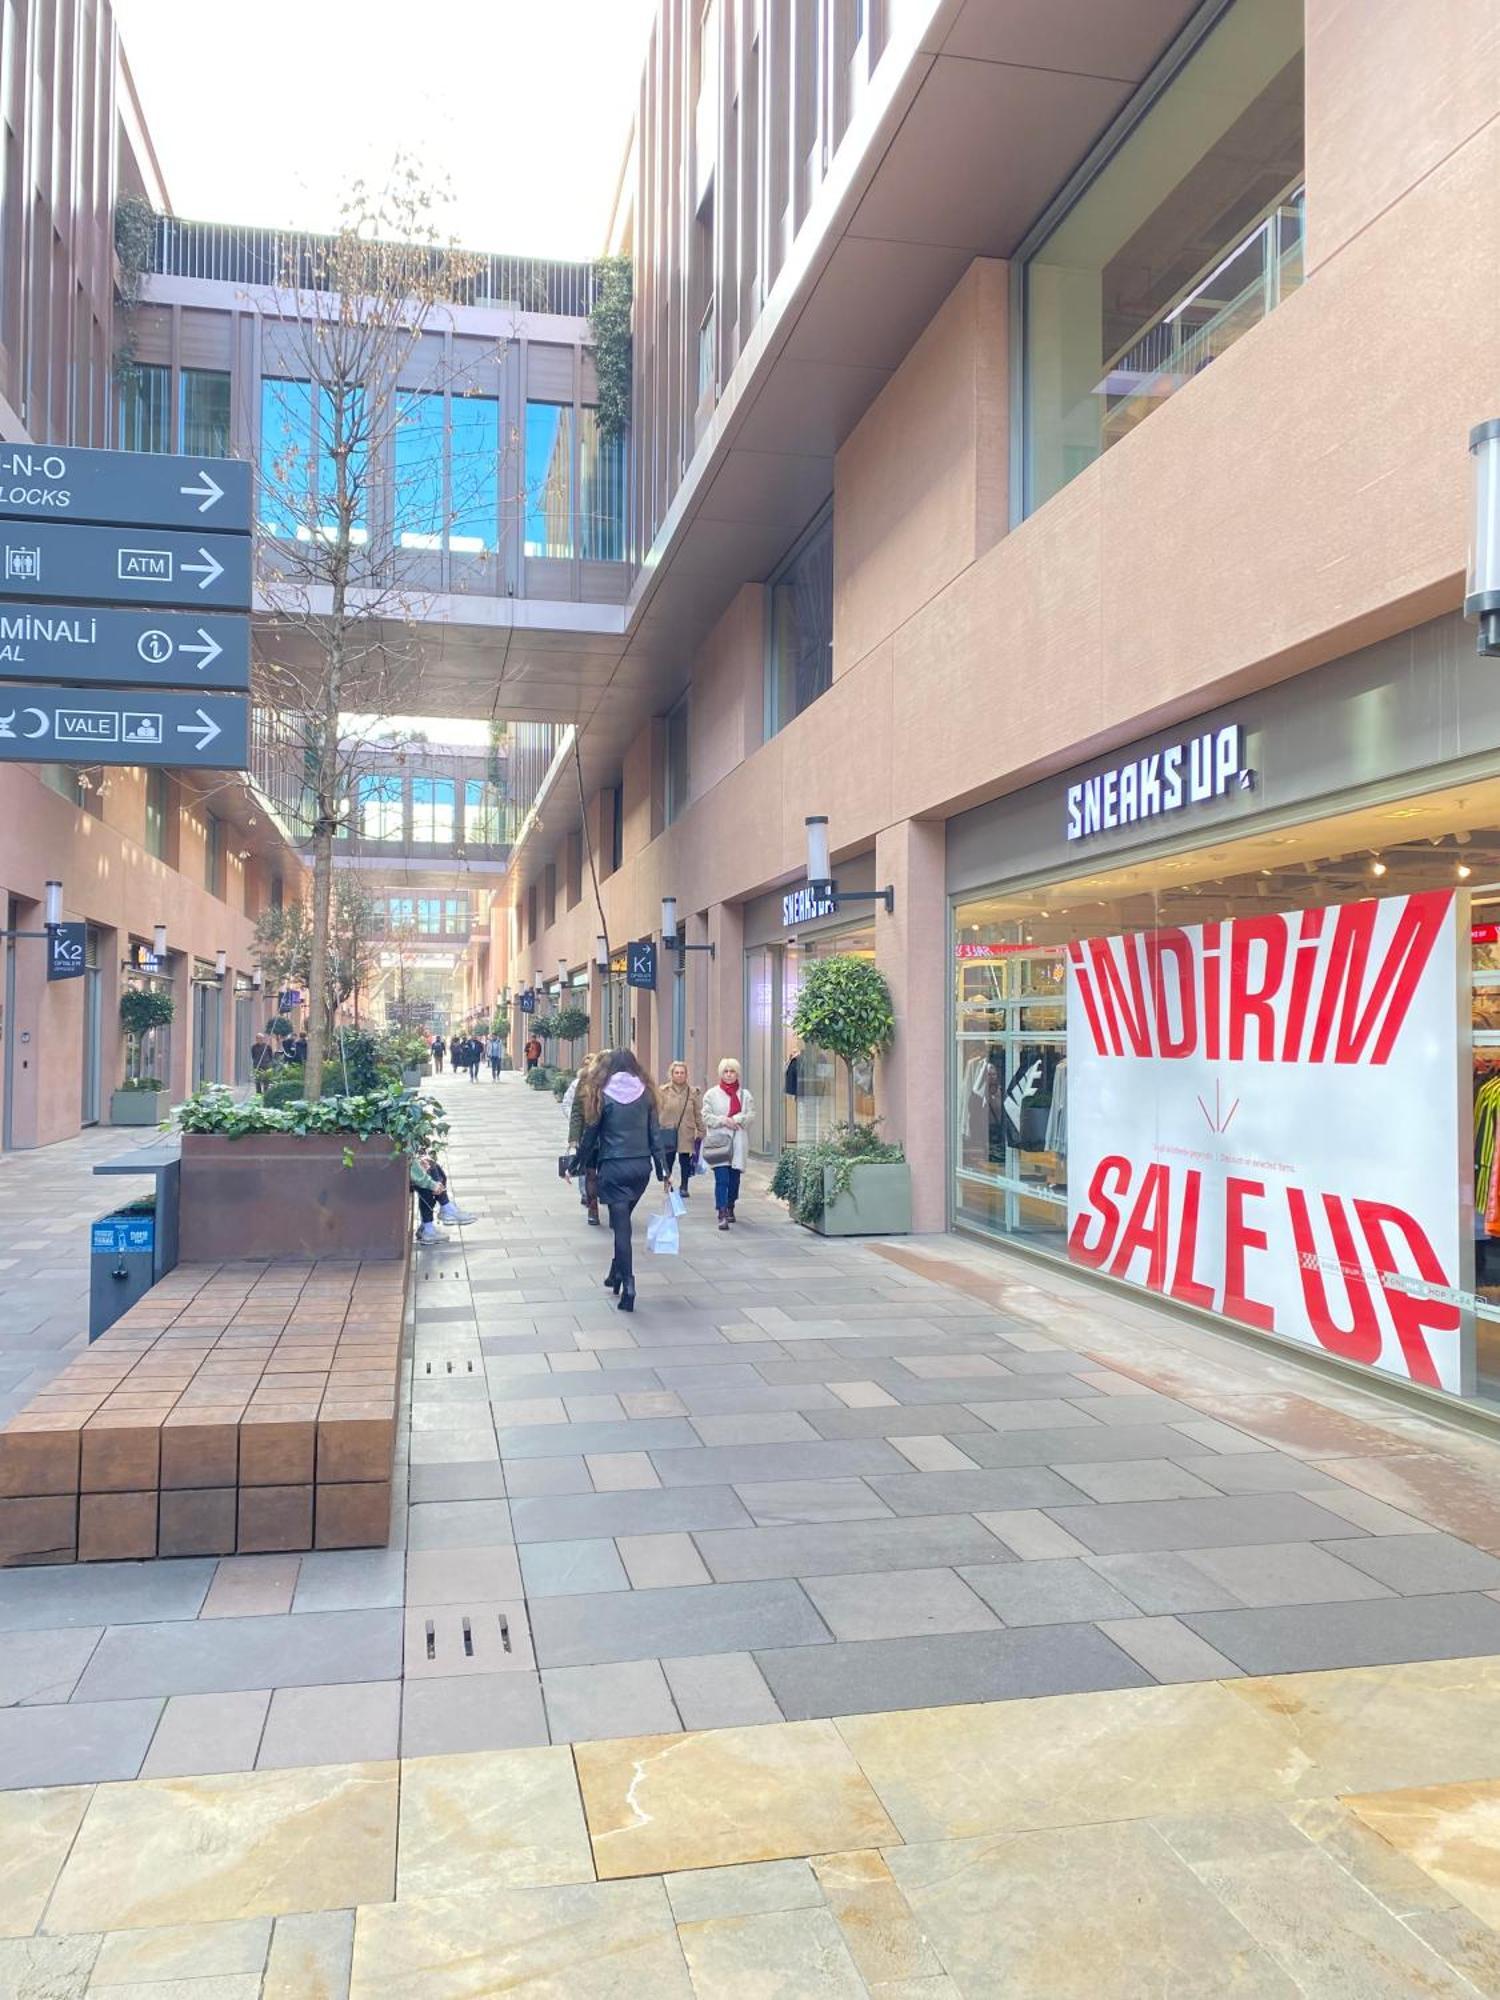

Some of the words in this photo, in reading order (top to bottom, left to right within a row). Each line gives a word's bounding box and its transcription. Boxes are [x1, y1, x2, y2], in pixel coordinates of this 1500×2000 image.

[0, 486, 71, 507] LOCKS
[127, 557, 165, 574] ATM
[0, 614, 96, 643] MİNALİ
[0, 645, 25, 661] AL
[64, 717, 110, 734] VALE
[54, 940, 82, 960] K2
[634, 956, 652, 973] K1
